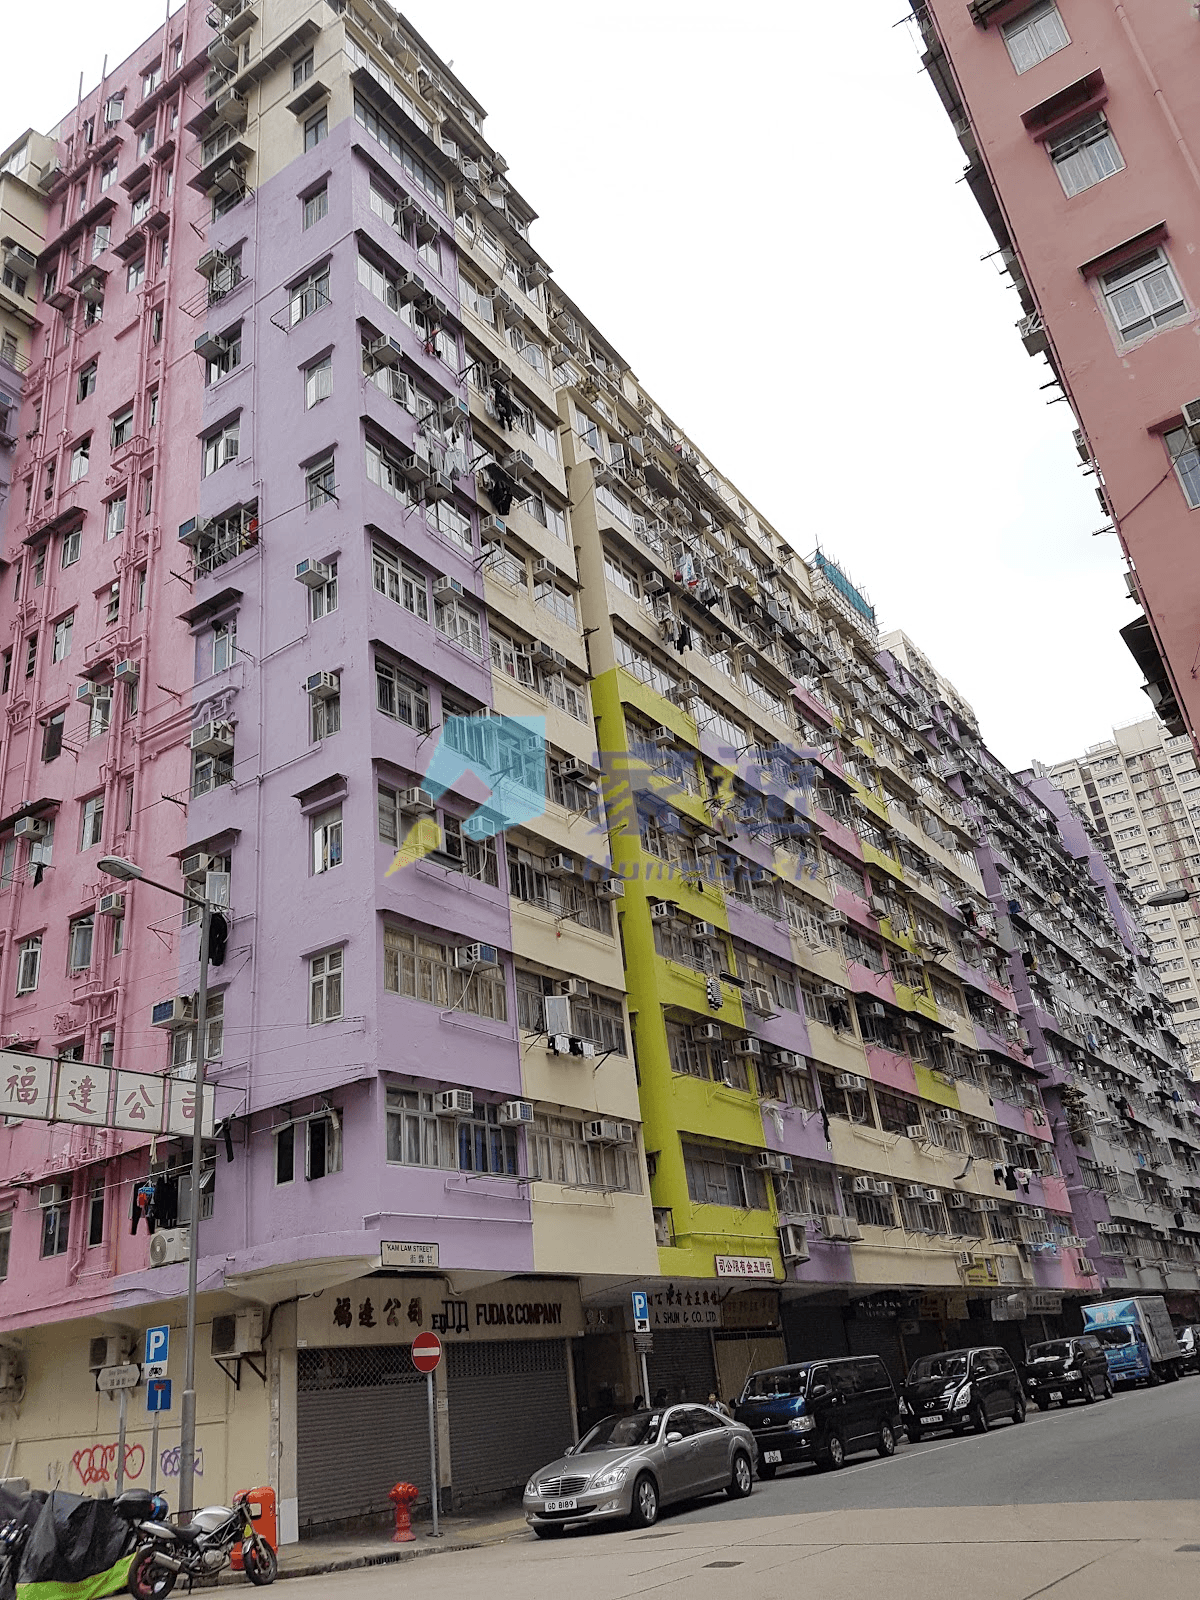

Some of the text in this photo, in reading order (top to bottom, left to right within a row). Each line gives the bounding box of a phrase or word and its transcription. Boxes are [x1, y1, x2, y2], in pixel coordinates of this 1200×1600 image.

[387, 1244, 399, 1252] KAM
[333, 1297, 423, 1329] 福達公司
[634, 1295, 645, 1318] P
[149, 1330, 165, 1360] P
[558, 1500, 574, 1509] 8189
